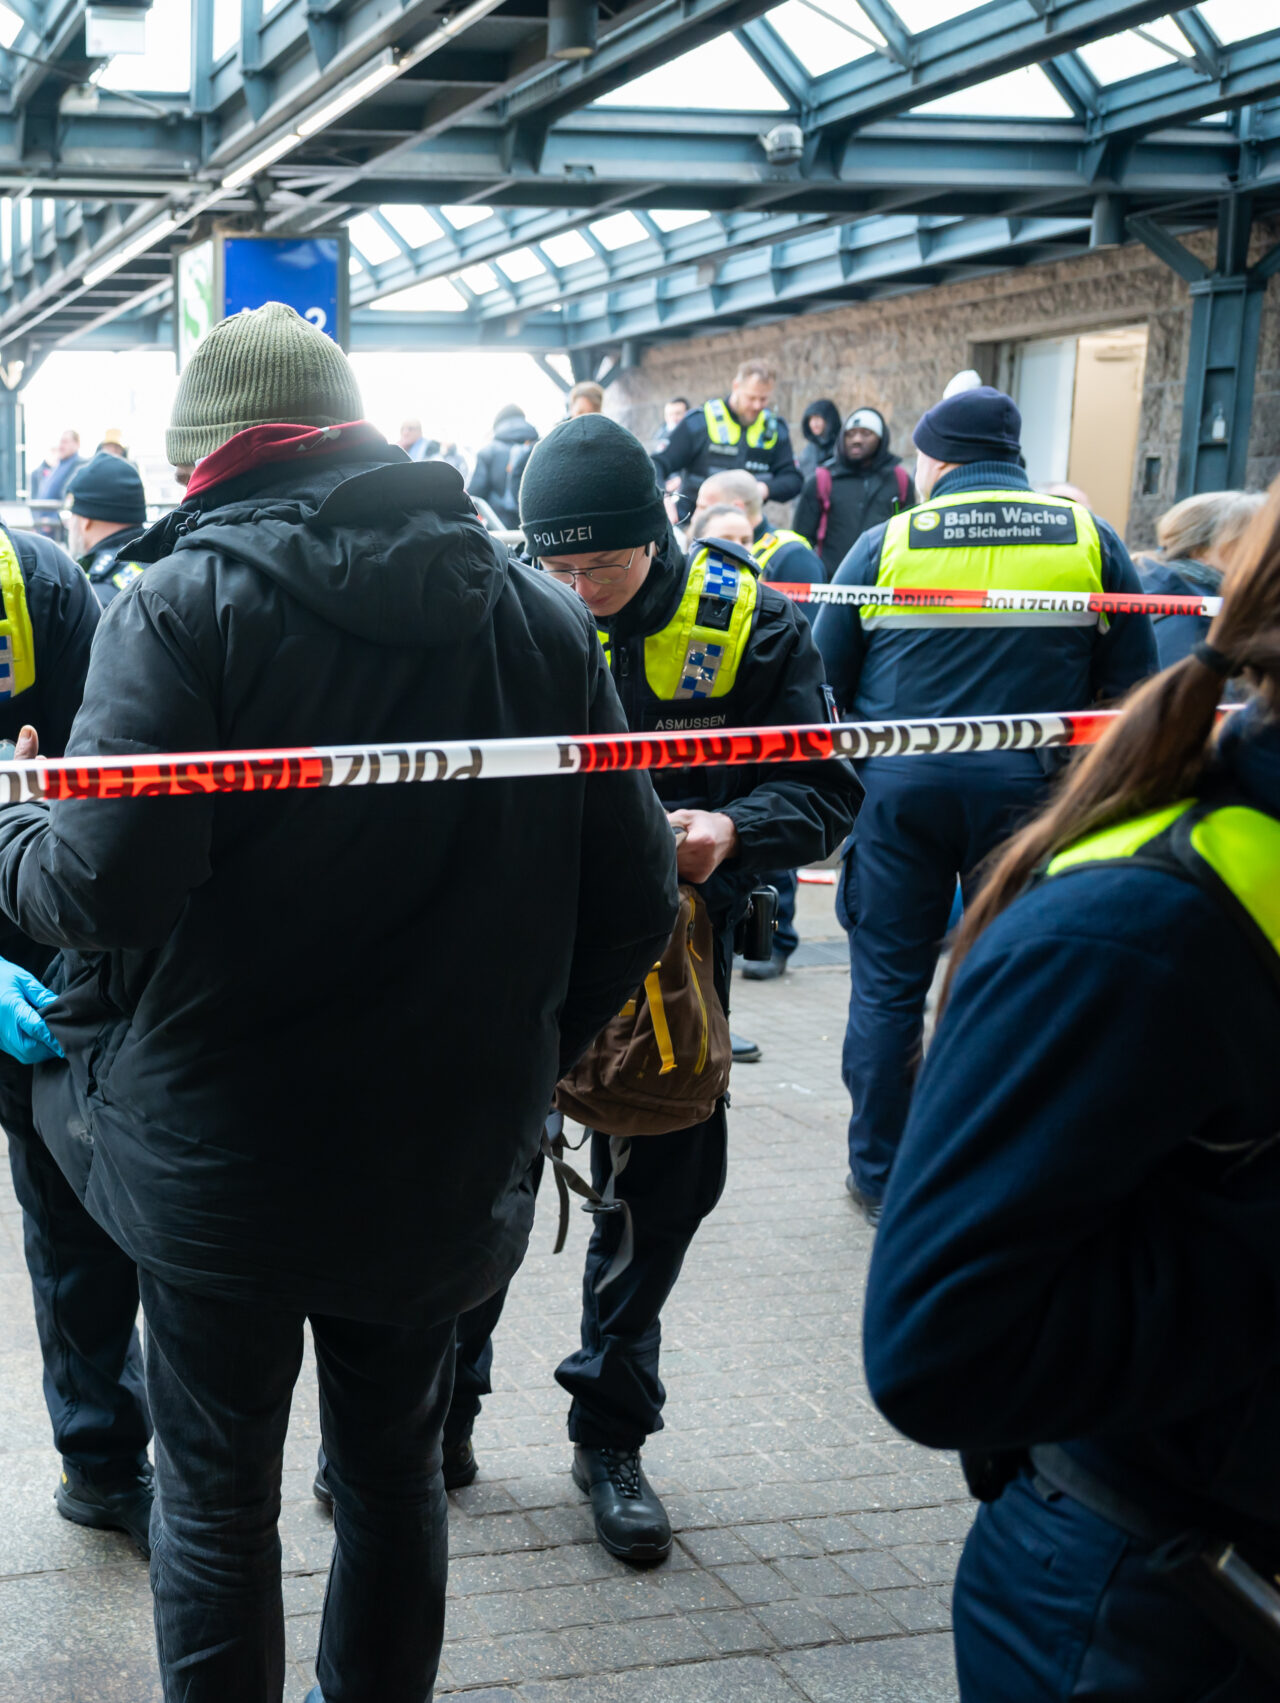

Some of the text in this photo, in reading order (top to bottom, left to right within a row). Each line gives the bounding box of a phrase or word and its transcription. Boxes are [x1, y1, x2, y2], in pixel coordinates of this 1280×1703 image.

[944, 506, 1068, 527] Bahn Wache
[533, 525, 593, 547] POLIZEI
[943, 525, 1042, 540] DB Sicherheit
[655, 714, 727, 731] ASMUSSEN
